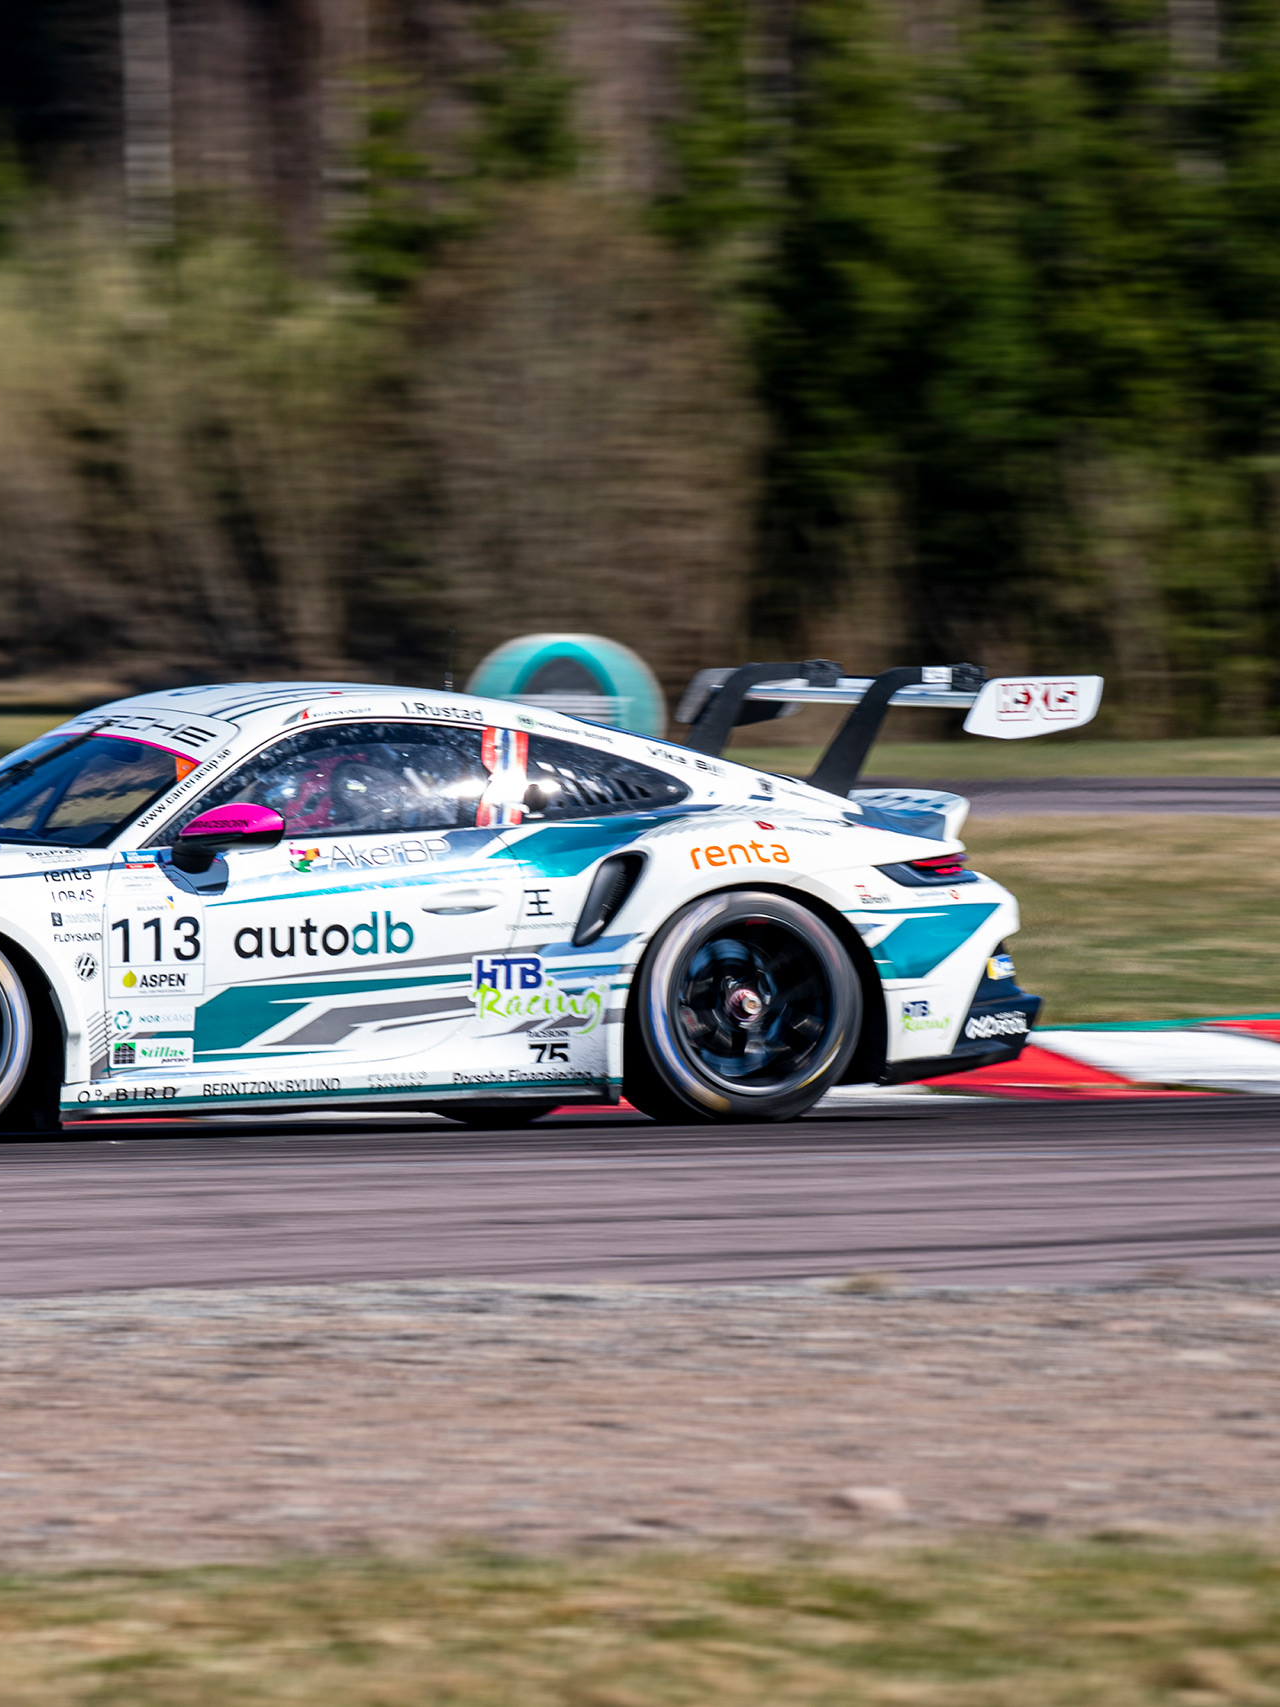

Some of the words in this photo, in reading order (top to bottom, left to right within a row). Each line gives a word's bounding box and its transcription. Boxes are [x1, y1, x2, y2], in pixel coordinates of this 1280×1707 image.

[401, 701, 484, 722] I.Rustad
[137, 748, 231, 829] www.carreracup.se
[690, 839, 790, 869] renta
[43, 868, 92, 882] renta
[111, 916, 201, 963] 113
[235, 911, 414, 958] autodb
[140, 973, 186, 988] ASPEN
[476, 956, 543, 989] HTB
[474, 980, 607, 1034] Racing
[139, 1013, 193, 1024] NORSKAND
[139, 1046, 185, 1058] Stillas
[528, 1042, 569, 1064] 75
[453, 1072, 505, 1085] Porsche
[508, 1068, 593, 1084] Finansiering
[116, 1086, 177, 1101] BIRD
